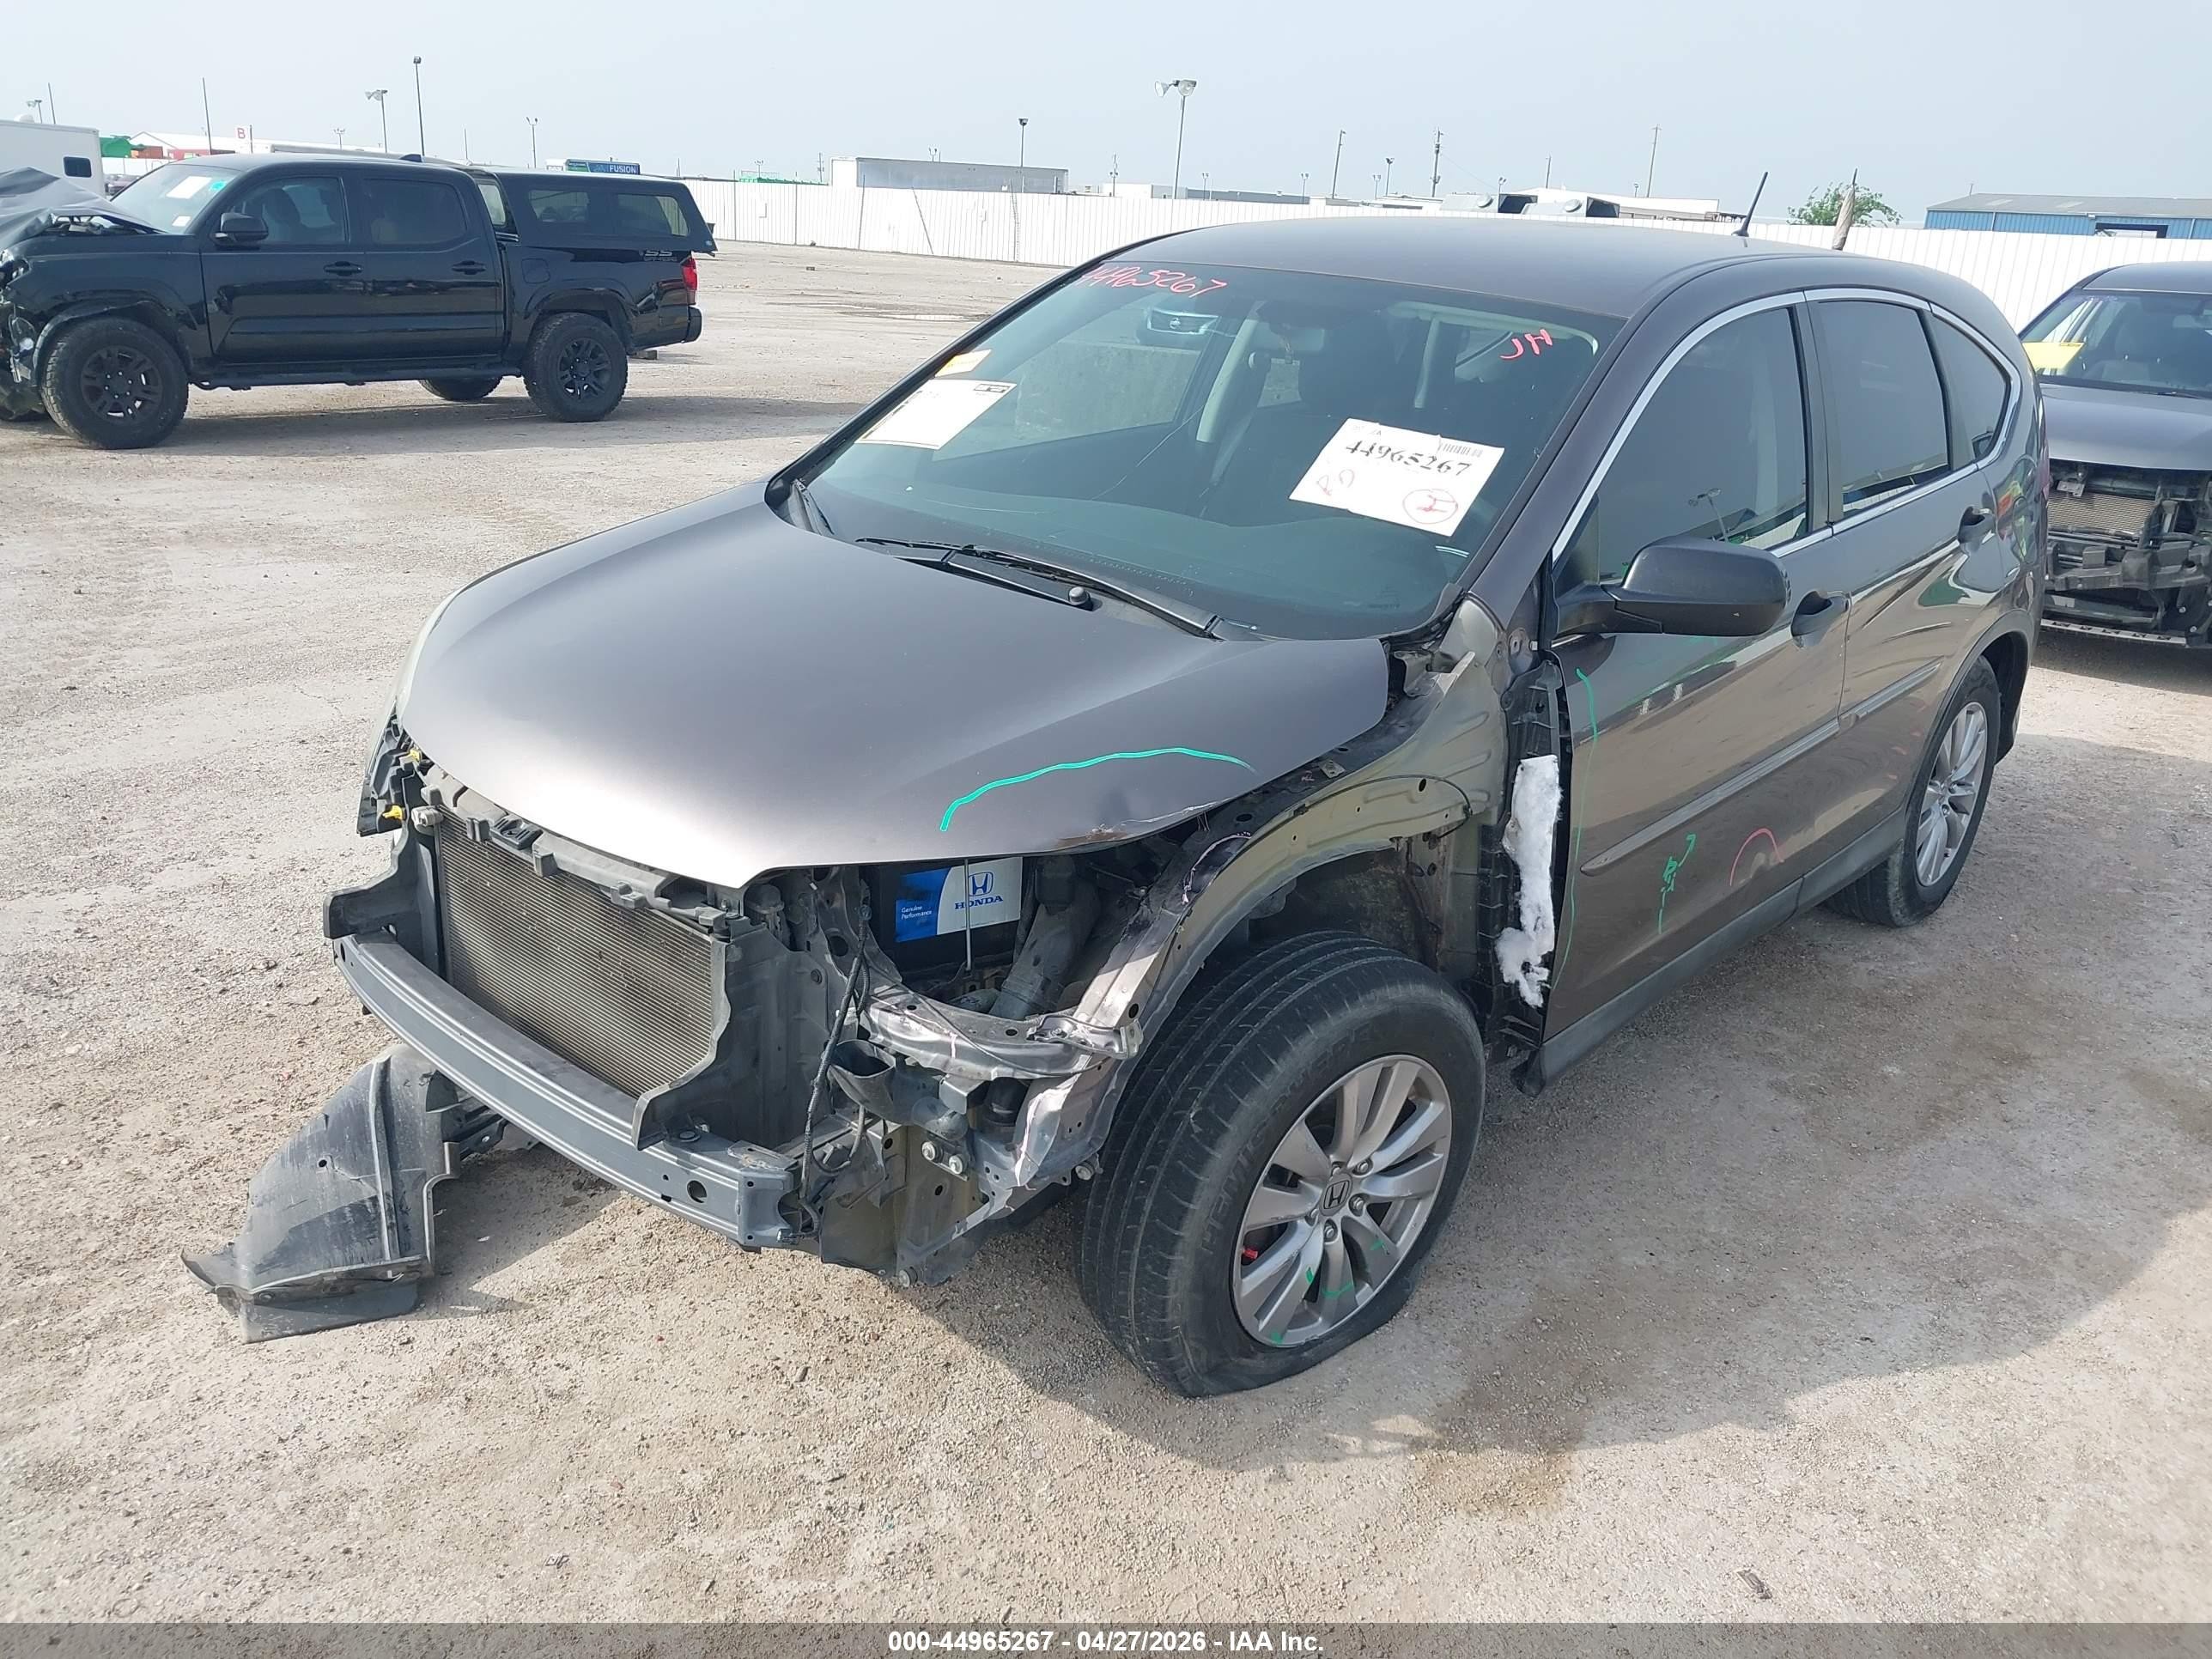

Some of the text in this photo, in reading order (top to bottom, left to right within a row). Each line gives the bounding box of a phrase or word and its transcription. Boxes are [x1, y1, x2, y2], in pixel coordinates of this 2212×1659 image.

[237, 127, 246, 139] B
[609, 164, 636, 173] FUSION
[1346, 440, 1472, 476] 44965267
[954, 895, 1004, 910] HONDA
[901, 905, 923, 914] Genuine
[901, 910, 933, 920] Performance
